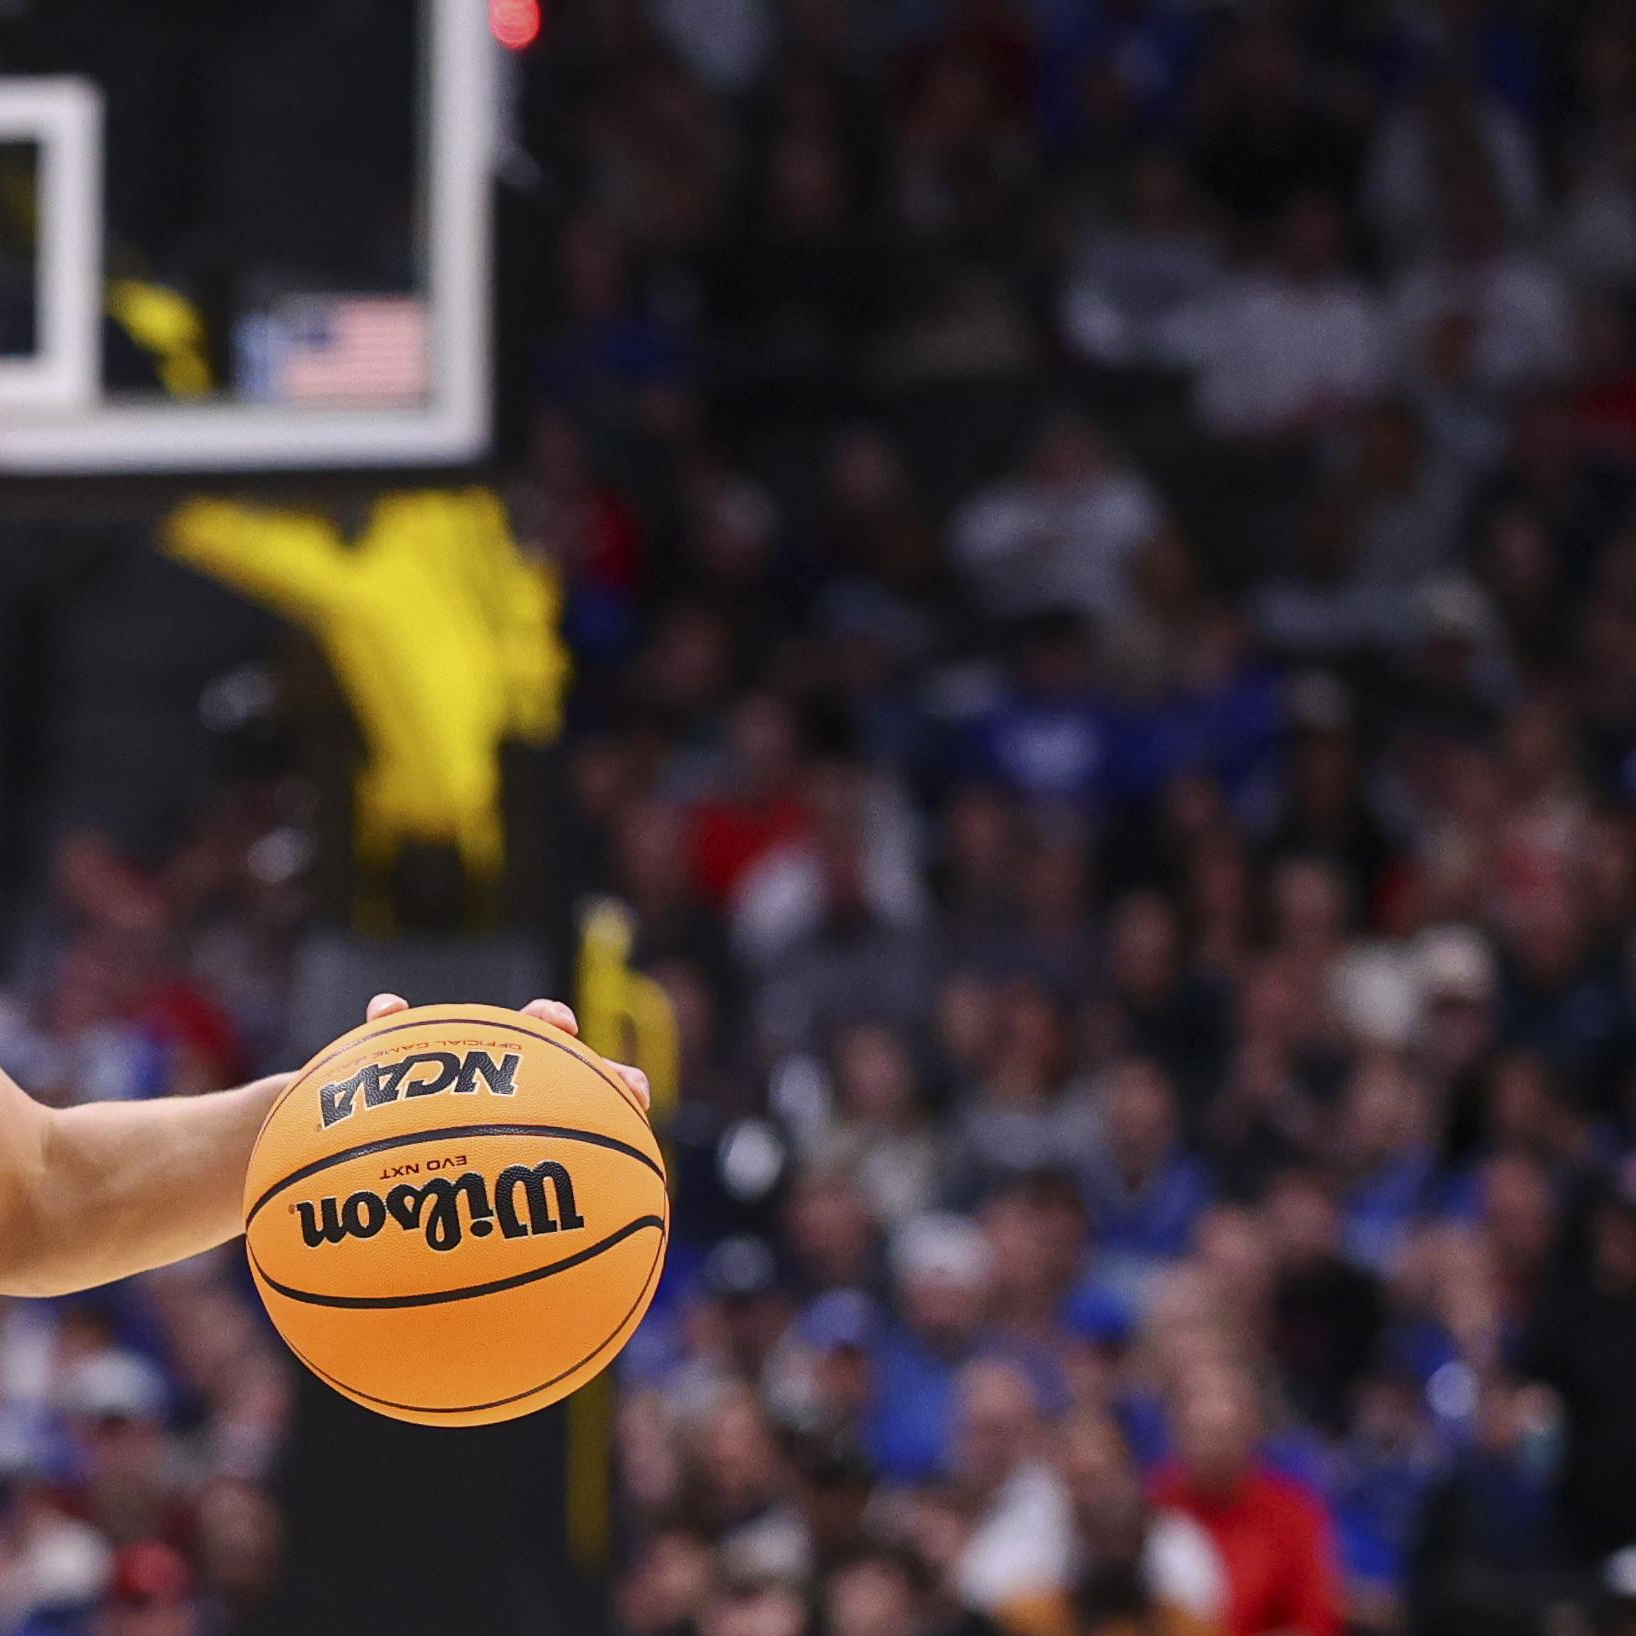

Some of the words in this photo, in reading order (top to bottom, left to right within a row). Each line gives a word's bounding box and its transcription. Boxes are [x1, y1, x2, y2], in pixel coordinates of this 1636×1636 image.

[318, 1050, 523, 1131] NCAA
[379, 1162, 421, 1181] NXT
[426, 1154, 468, 1175] EVO
[295, 1159, 586, 1253] Wilson
